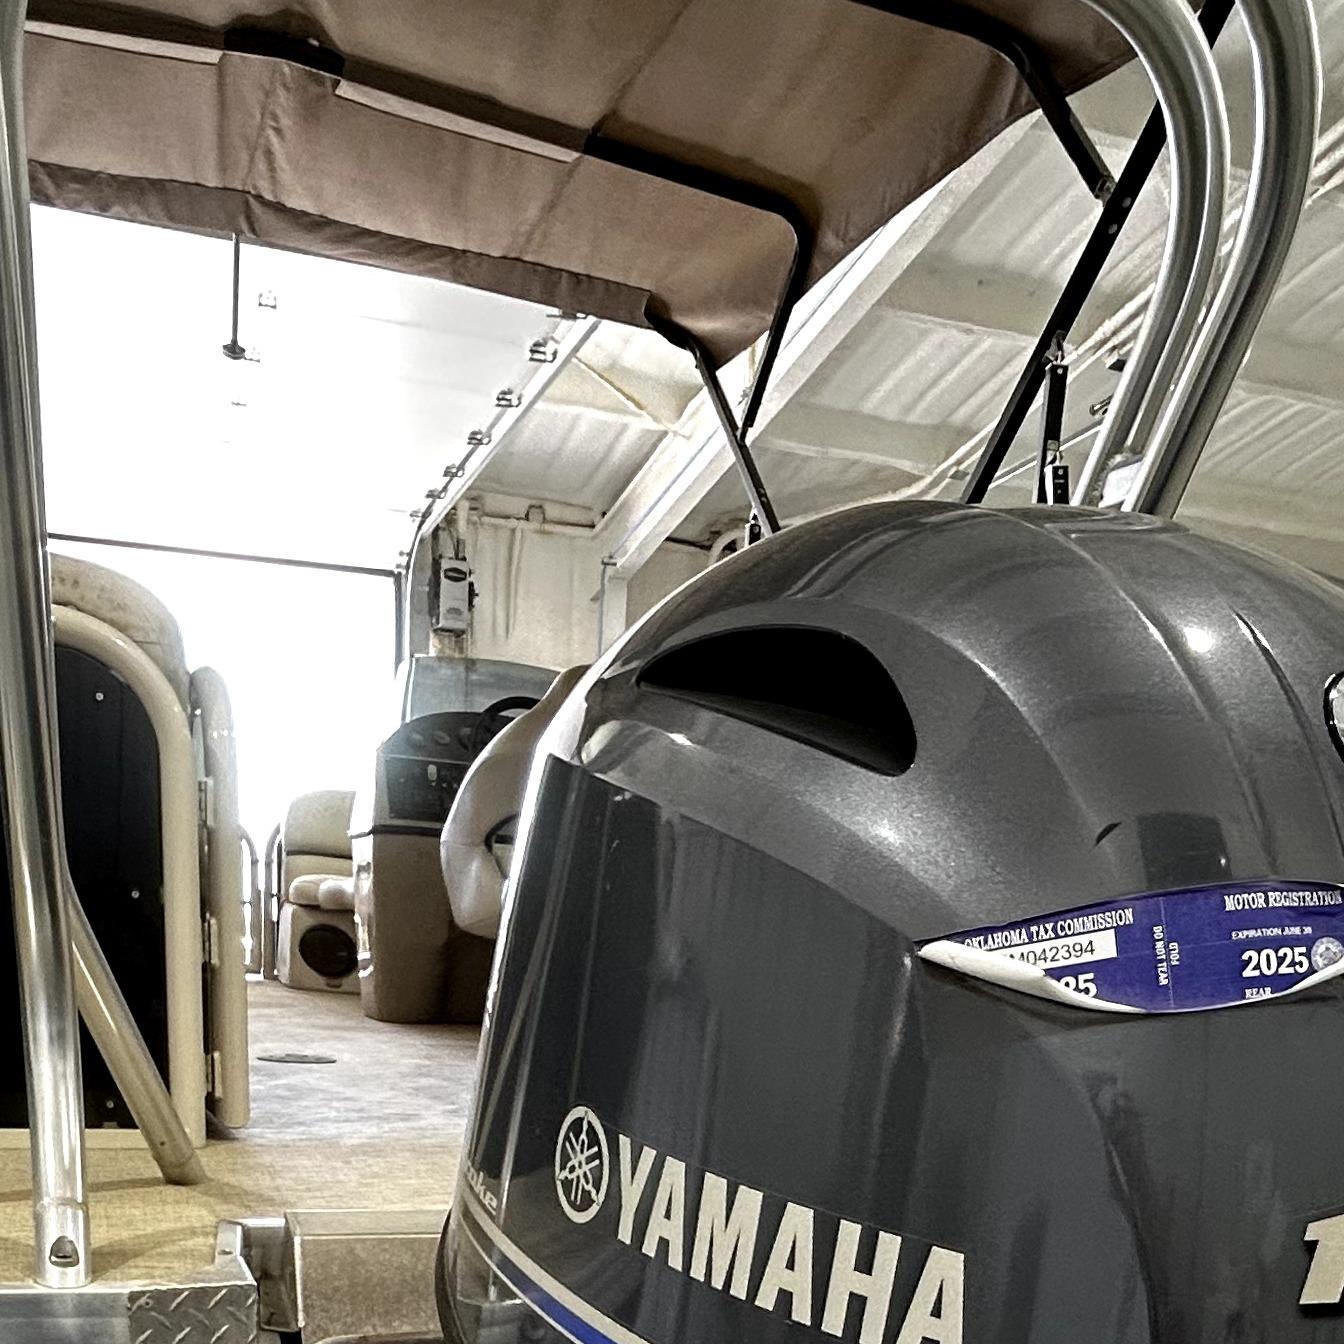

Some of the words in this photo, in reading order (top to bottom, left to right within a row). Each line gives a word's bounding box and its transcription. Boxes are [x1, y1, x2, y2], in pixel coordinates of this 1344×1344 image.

[1224, 893, 1265, 911] MOTOR
[1268, 890, 1343, 908] REGISTRATION
[964, 928, 1029, 951] OKLAHOMA
[1030, 922, 1056, 942] TAX
[1057, 907, 1134, 936] COMMISSION
[1153, 925, 1163, 940] DO
[1231, 927, 1282, 941] EXPIRATION
[1155, 940, 1166, 960] NOT
[1169, 942, 1180, 966] FOLD
[1241, 946, 1310, 978] 2025
[1157, 961, 1169, 986] TEAR
